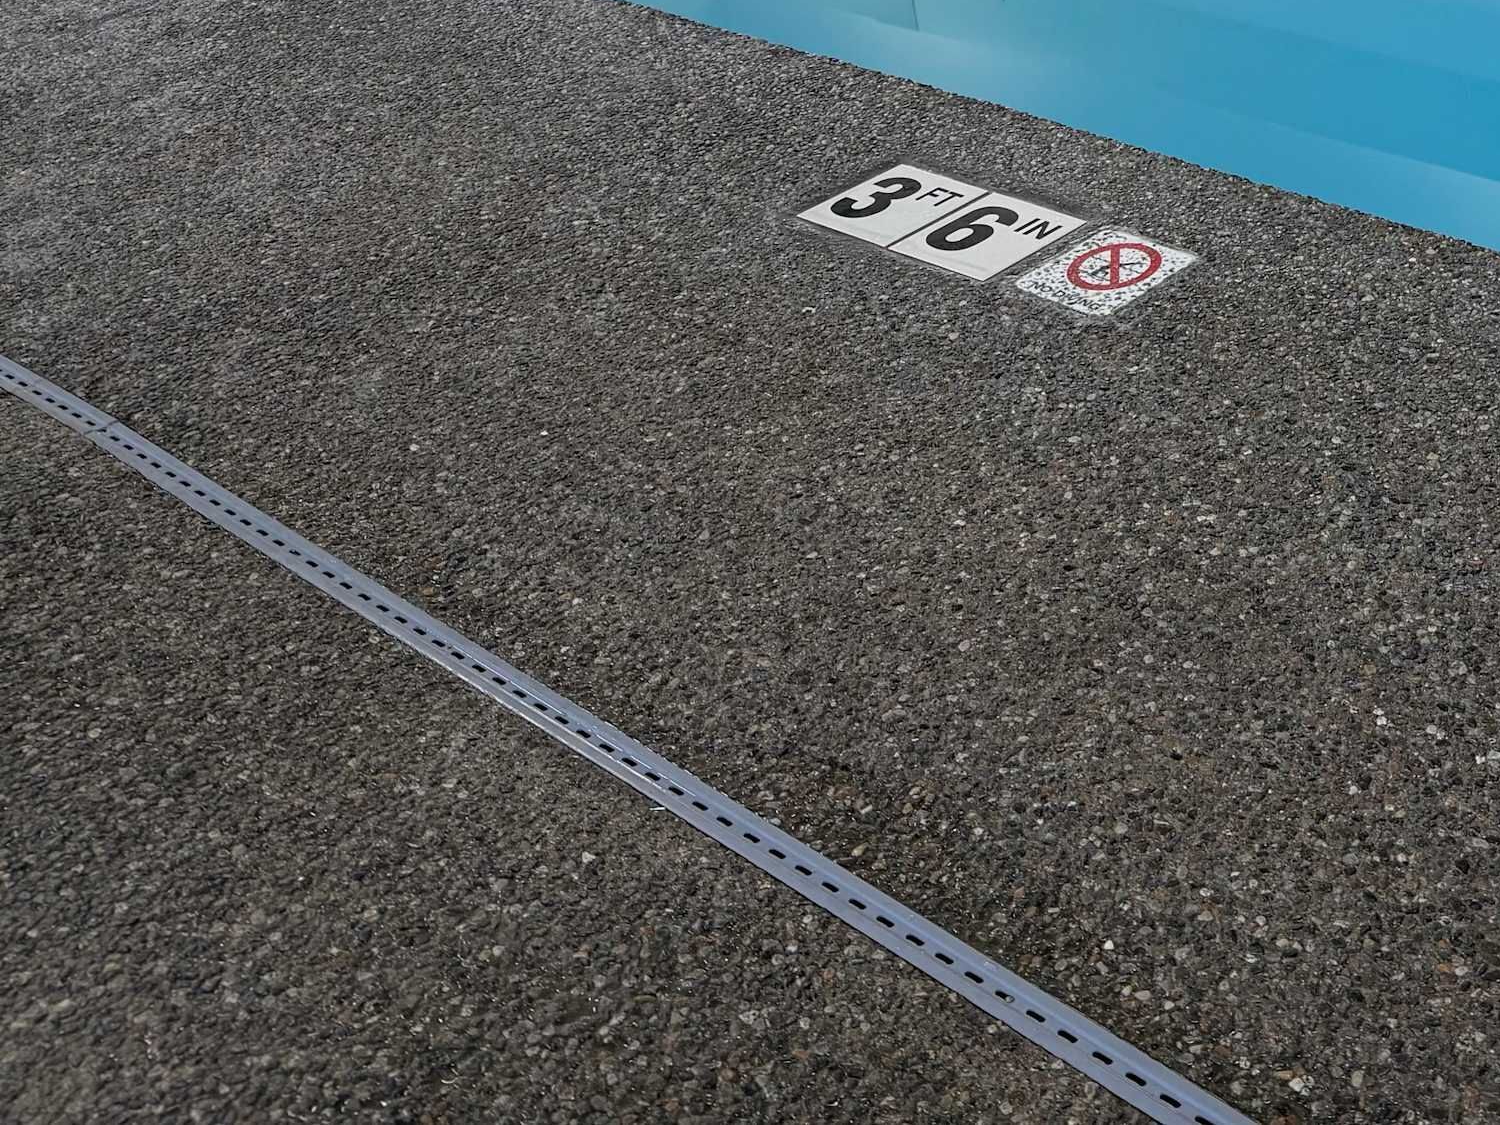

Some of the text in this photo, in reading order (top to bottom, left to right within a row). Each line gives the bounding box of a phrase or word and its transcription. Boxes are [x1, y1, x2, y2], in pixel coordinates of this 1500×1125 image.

[829, 177, 1064, 252] 3 FT 6 IN
